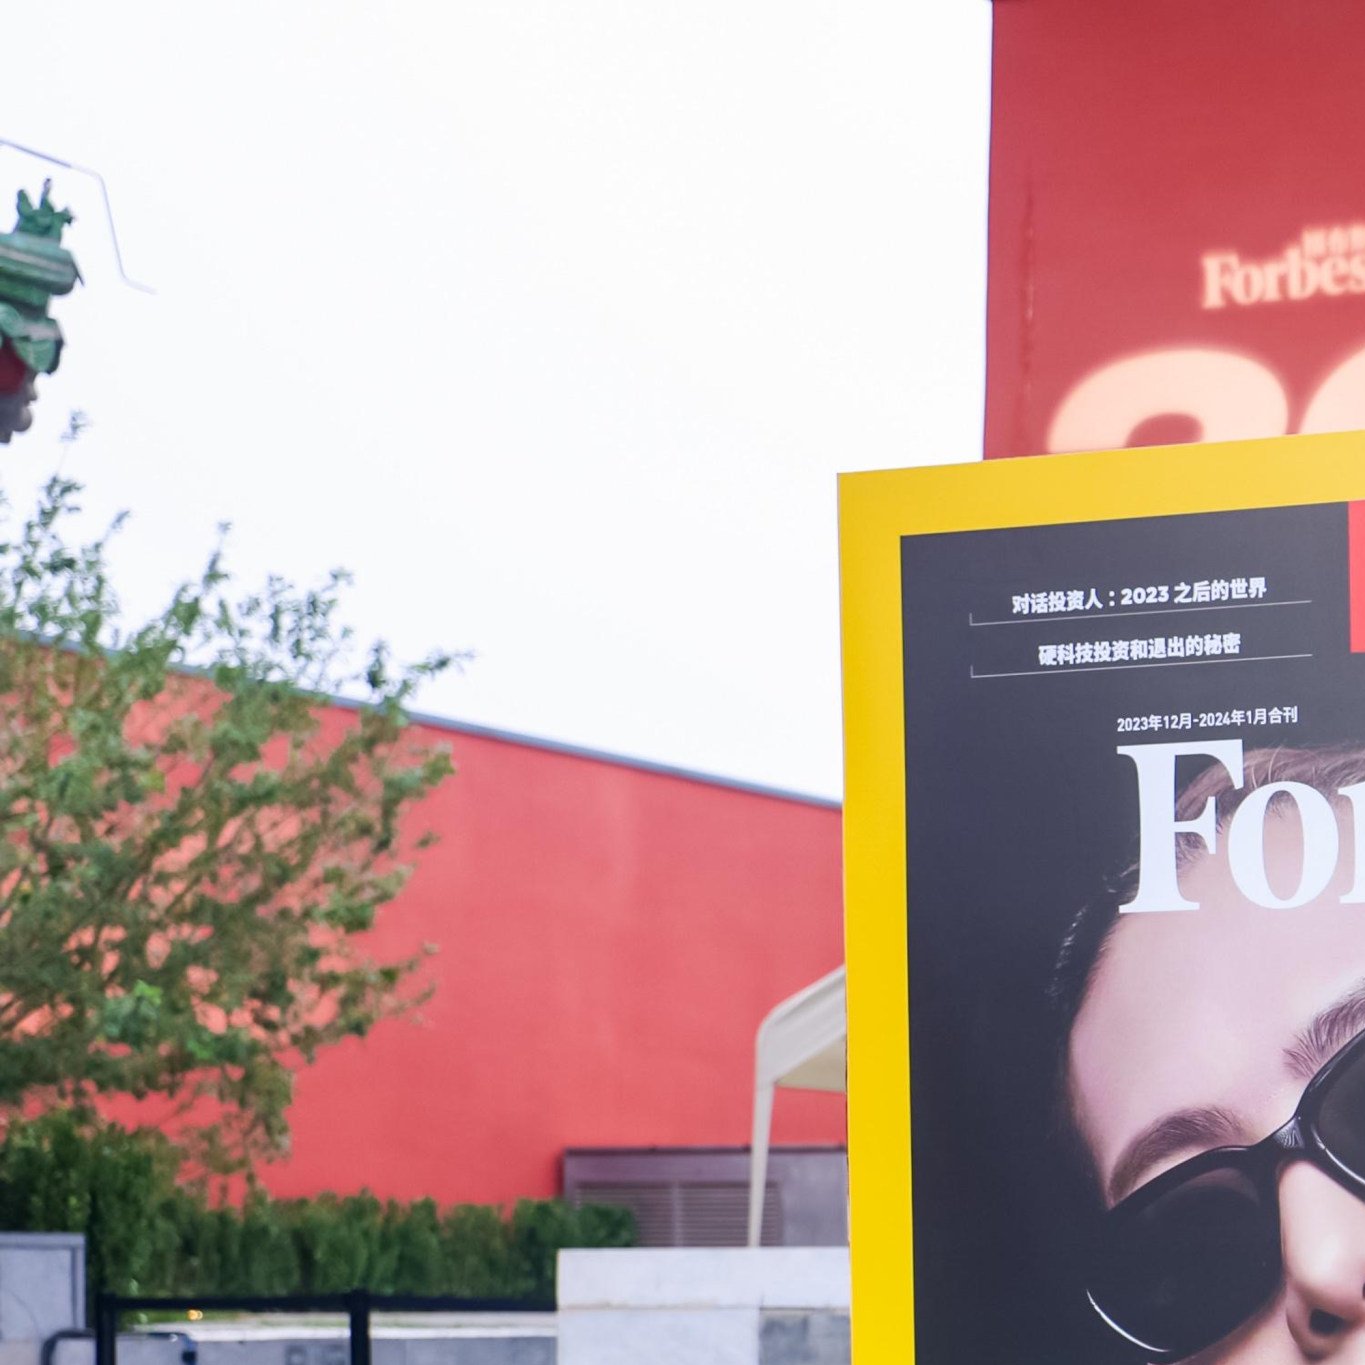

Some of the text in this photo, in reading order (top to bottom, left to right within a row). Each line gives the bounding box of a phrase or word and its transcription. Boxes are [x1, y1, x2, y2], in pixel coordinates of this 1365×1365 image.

[1038, 632, 1241, 666] 硬科技投资和退出的秘密
[1117, 705, 1299, 732] 2023年12月-2024年1月合刊
